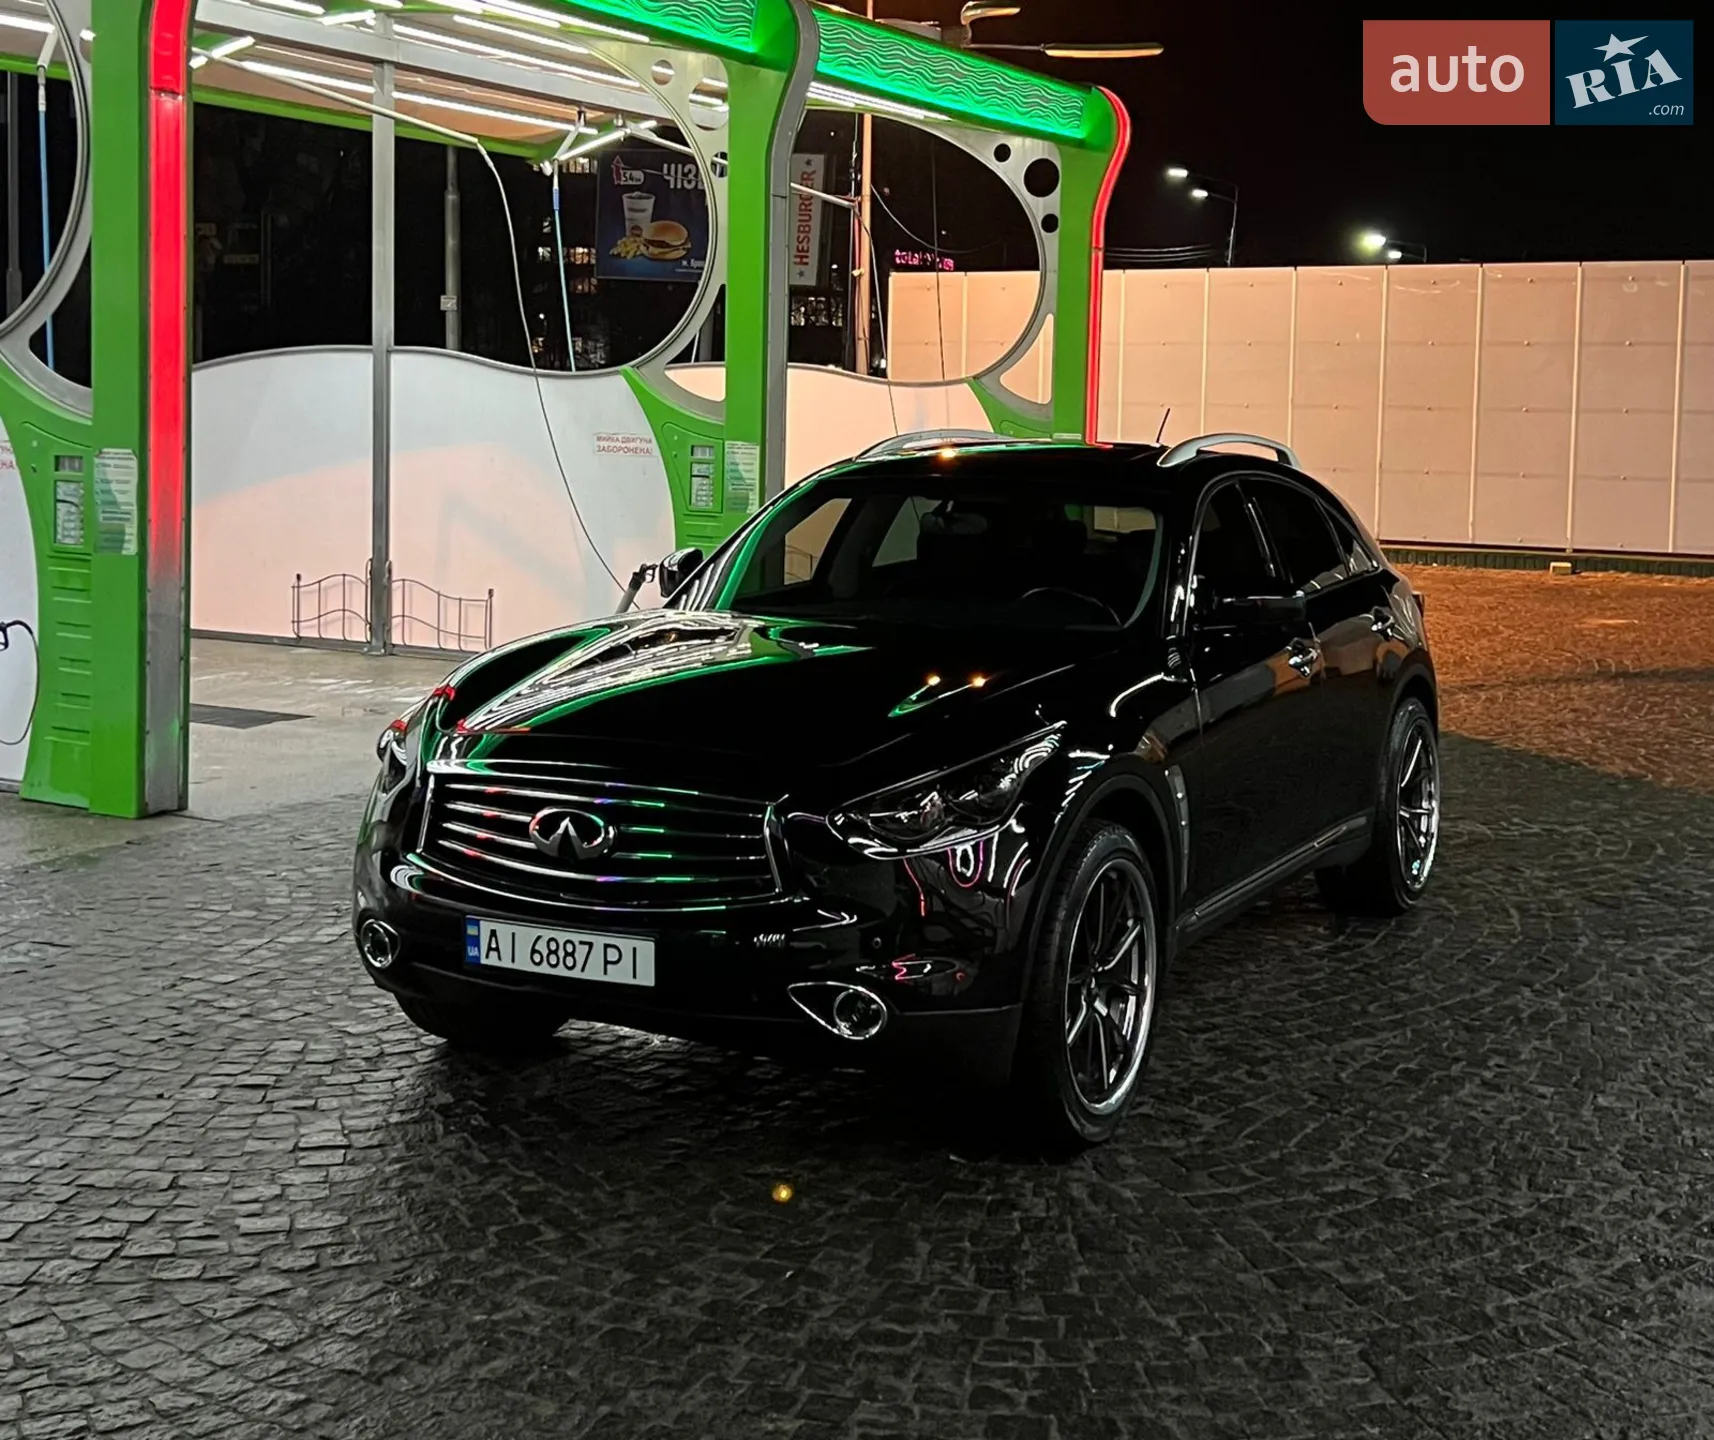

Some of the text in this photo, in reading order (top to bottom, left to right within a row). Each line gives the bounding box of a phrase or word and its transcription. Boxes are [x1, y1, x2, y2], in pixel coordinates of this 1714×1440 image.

[596, 435, 653, 445] МИЙКА ДВИГУНА
[467, 945, 480, 957] UA
[485, 928, 638, 980] AI 6887 PI
